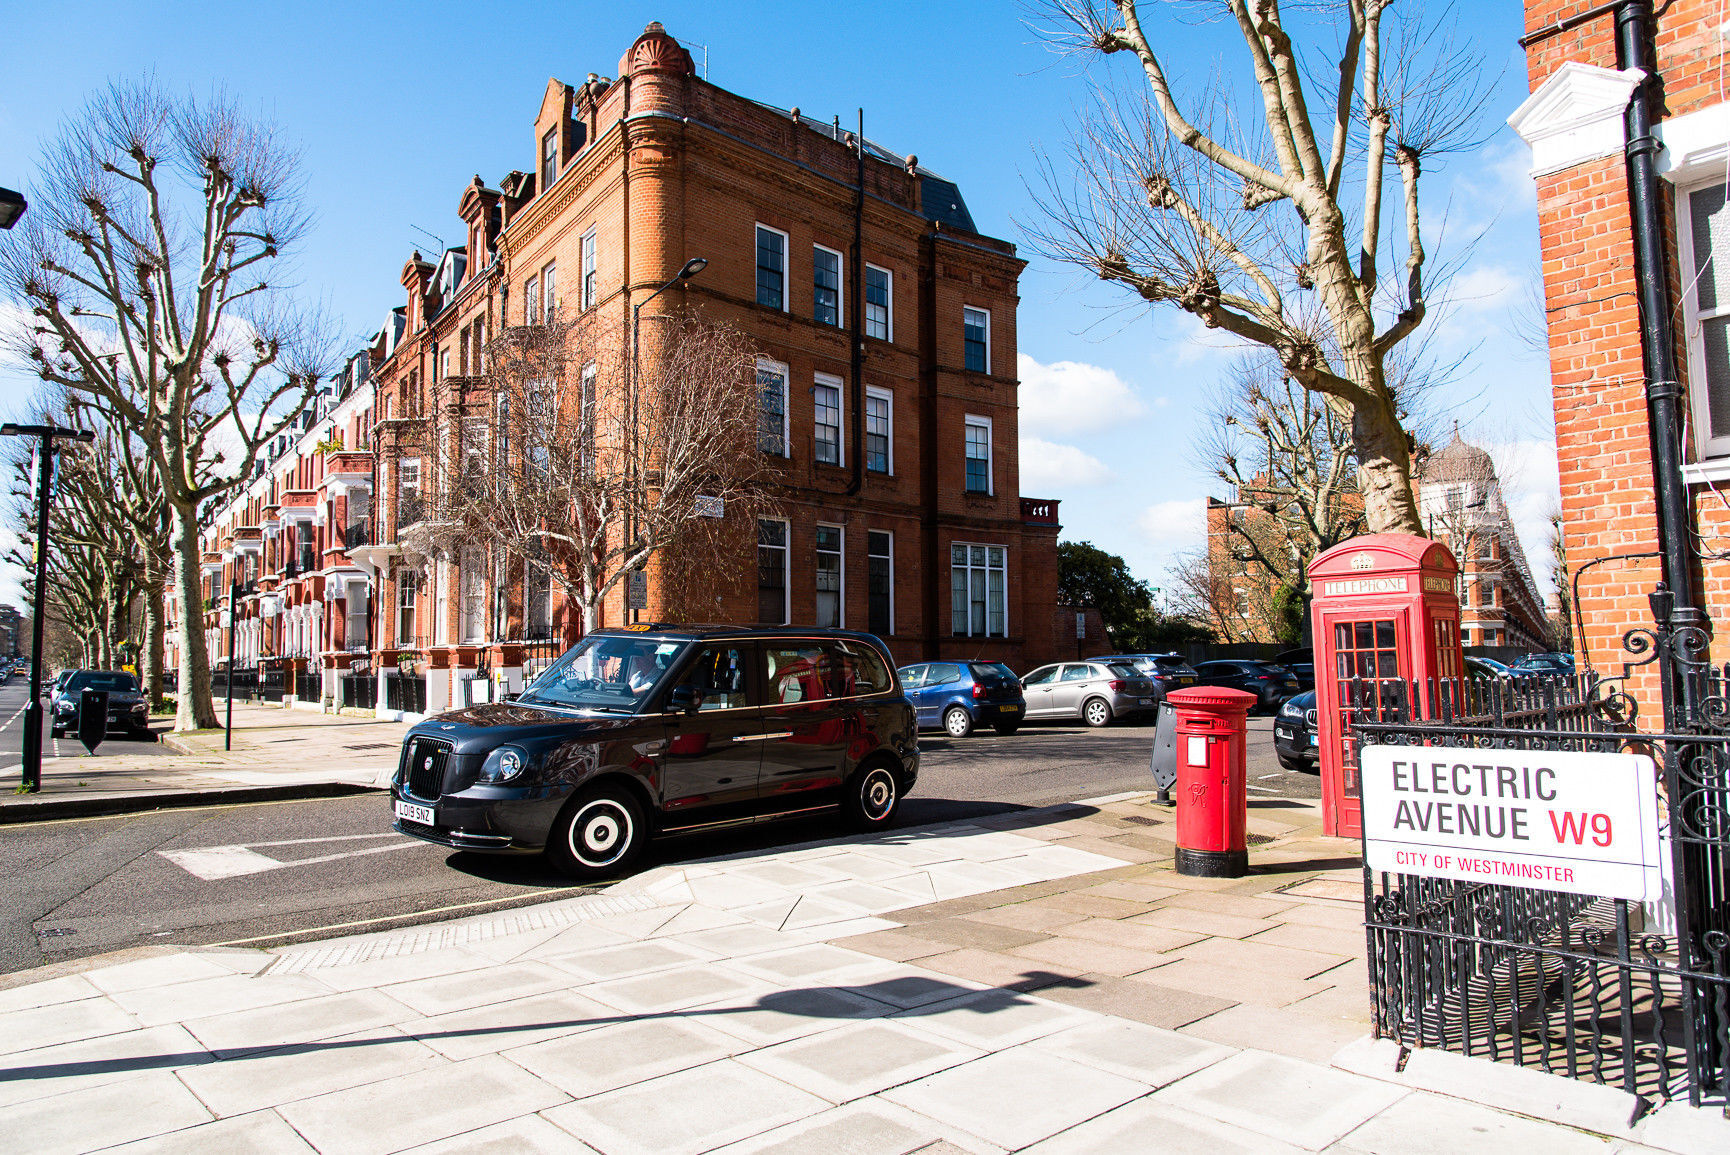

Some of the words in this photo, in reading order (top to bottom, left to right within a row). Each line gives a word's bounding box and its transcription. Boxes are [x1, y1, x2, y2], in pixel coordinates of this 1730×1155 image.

[1328, 578, 1405, 594] TELEPHONE
[1392, 761, 1557, 801] ELECTRIC
[400, 803, 414, 817] LO19
[416, 807, 429, 821] SNZ
[1393, 800, 1529, 840] AVENUE
[1548, 810, 1613, 847] W9
[1396, 851, 1427, 867] CITY
[1434, 855, 1452, 869] OF
[1458, 857, 1574, 883] WESTMINSTER
